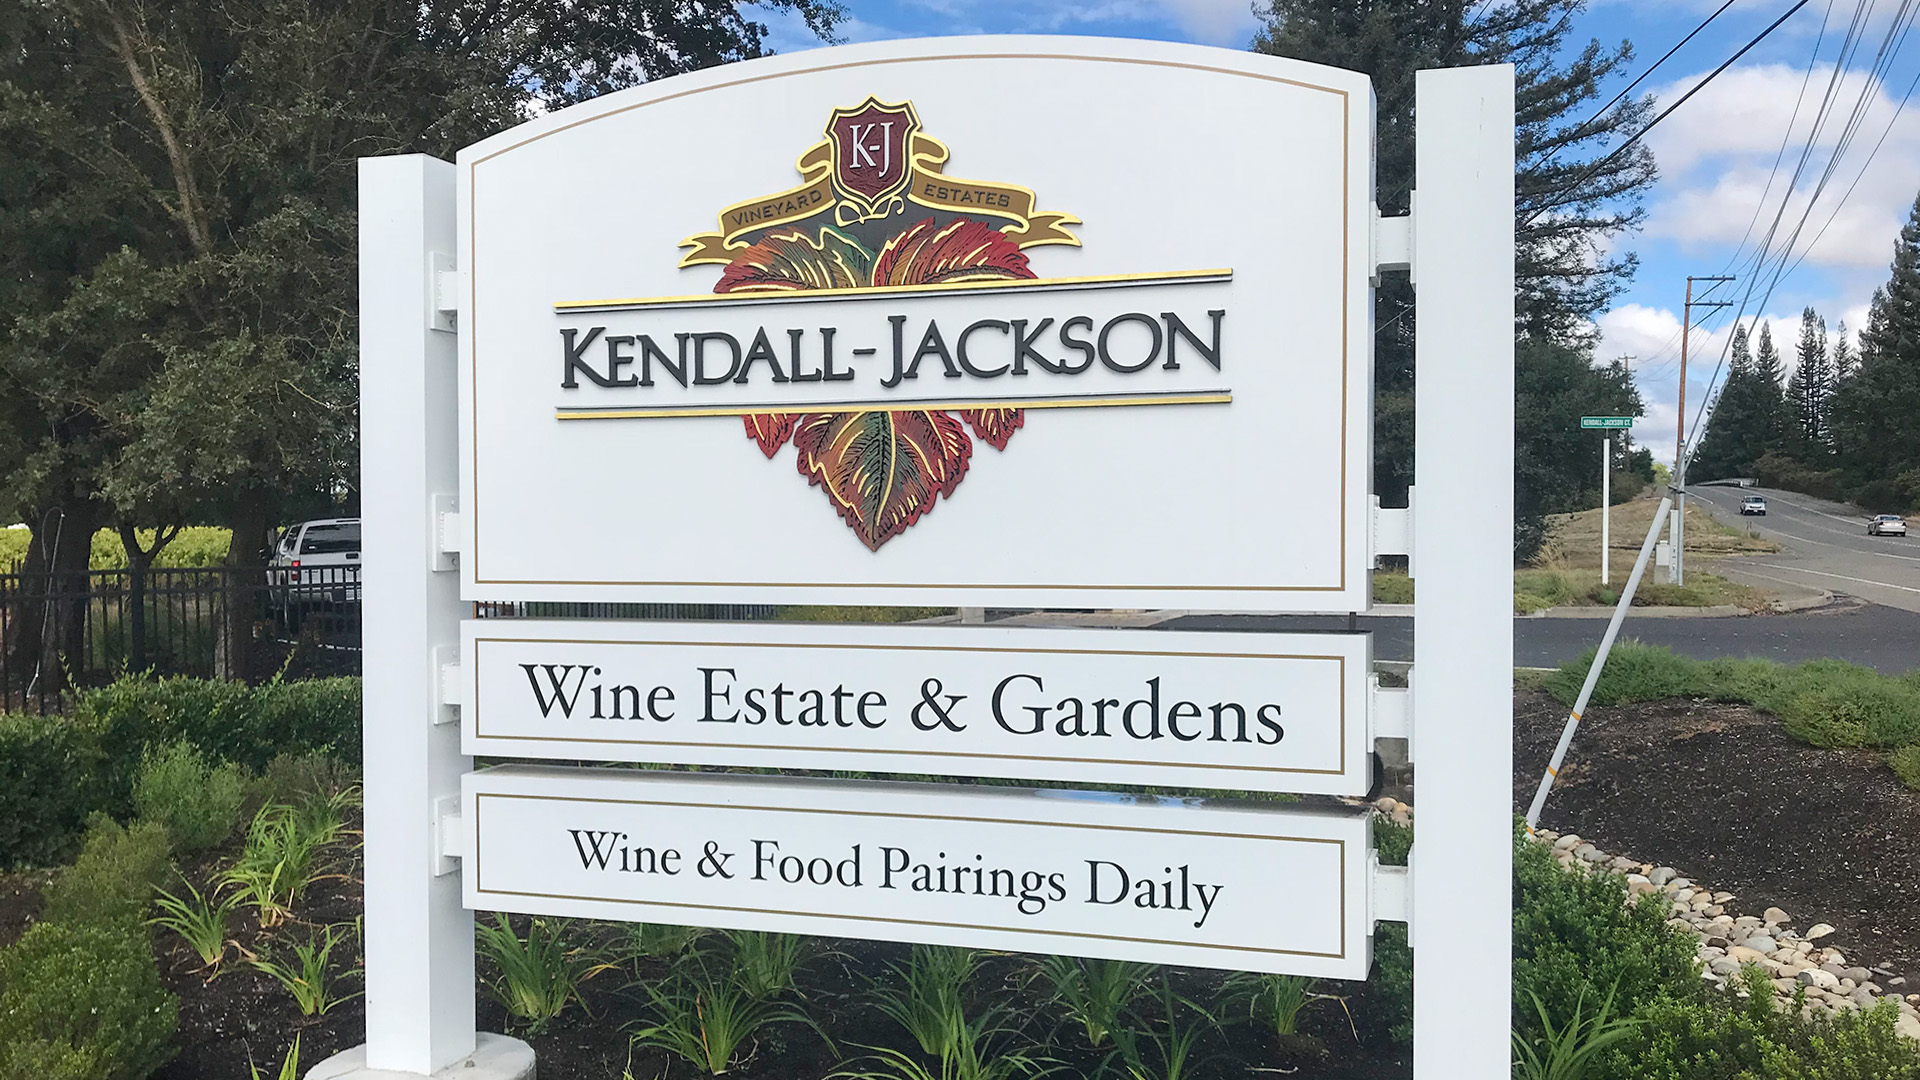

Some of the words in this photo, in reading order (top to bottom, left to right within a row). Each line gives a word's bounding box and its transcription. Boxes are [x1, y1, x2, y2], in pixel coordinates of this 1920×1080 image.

[849, 121, 894, 178] K-J
[731, 189, 822, 225] VINEYARD
[923, 183, 1010, 207] ESTATES
[560, 309, 1226, 389] KENDALL-JACKSON
[519, 664, 674, 721] Wine
[697, 667, 886, 729] Estate
[911, 678, 967, 732] &
[991, 674, 1284, 745] Gardens
[568, 830, 680, 875] Wine
[698, 841, 734, 878] &
[751, 839, 862, 889] Food
[879, 847, 1066, 914] Pairings
[1085, 859, 1224, 928] Daily
